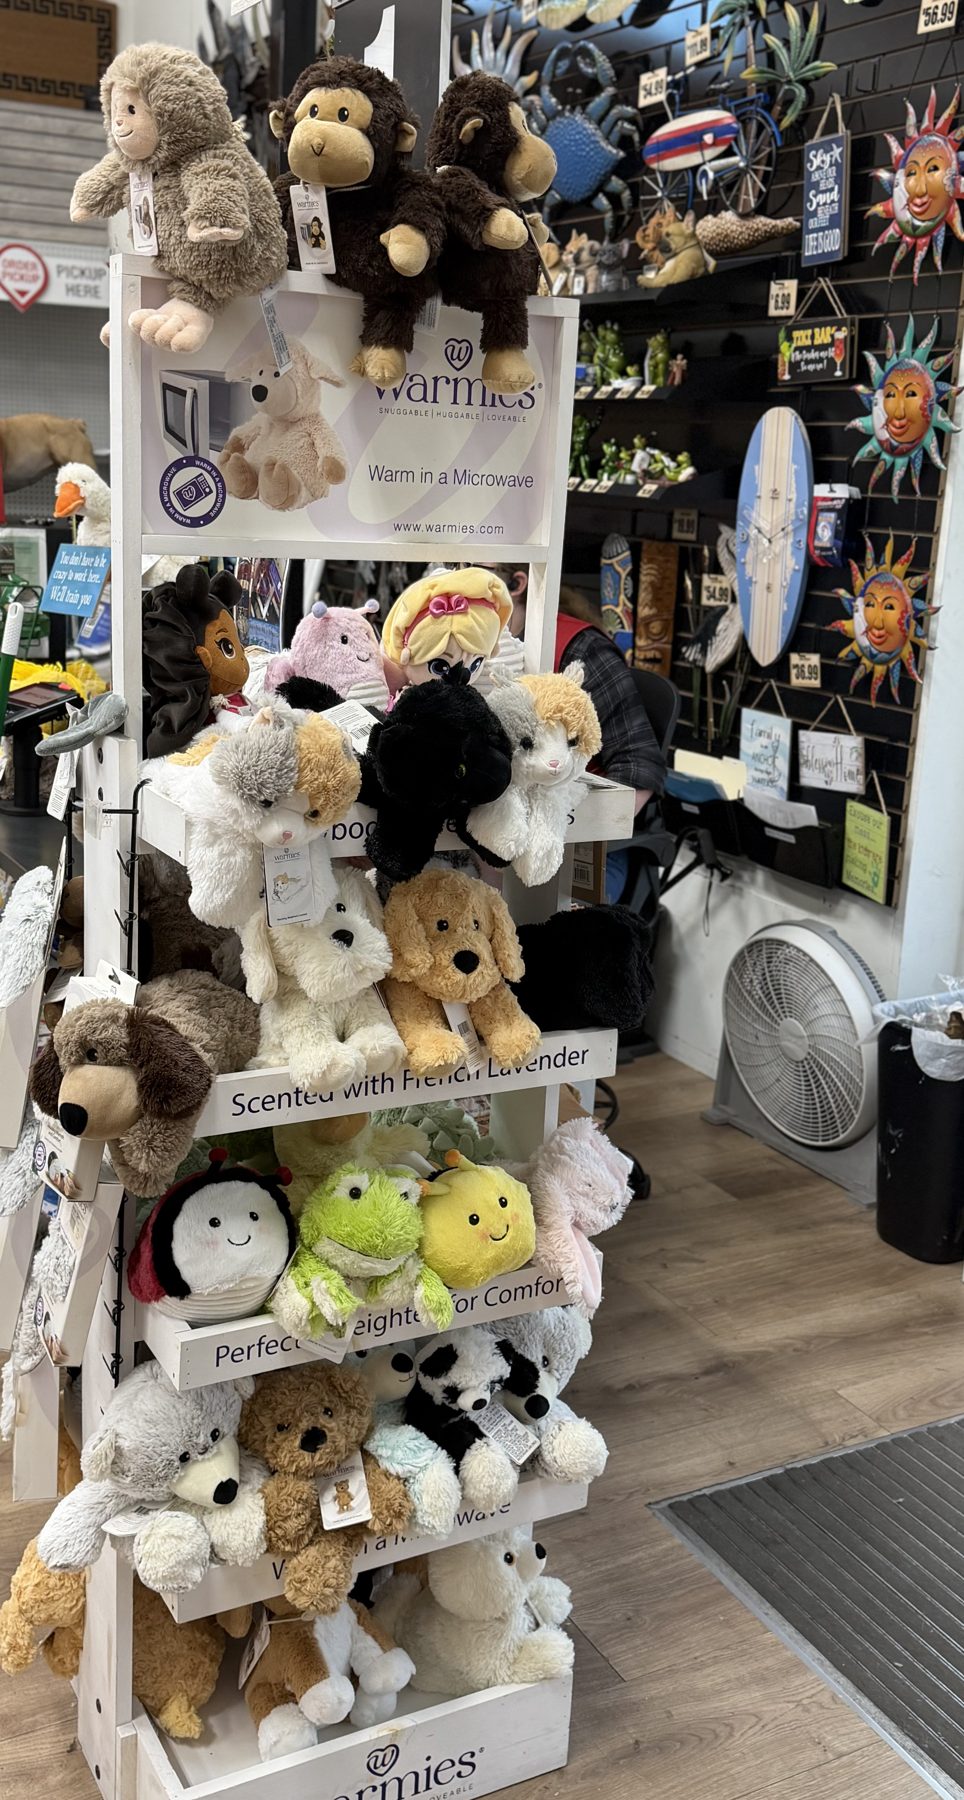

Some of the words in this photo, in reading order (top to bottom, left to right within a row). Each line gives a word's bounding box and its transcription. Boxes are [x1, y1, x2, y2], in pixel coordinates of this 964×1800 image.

[806, 148, 832, 172] Sky
[806, 184, 840, 212] Sand
[804, 233, 817, 256] LIFE
[818, 231, 824, 254] IS
[824, 228, 841, 253] GOOD
[56, 264, 107, 281] PICKUP
[65, 283, 102, 300] HERE
[792, 329, 812, 347] TIKI
[813, 326, 832, 346] BAR
[378, 407, 429, 417] SNUGGABLE
[436, 411, 480, 420] HUGGABLE
[487, 414, 527, 423] LOVEABLE
[162, 466, 177, 502] MICROWAVE
[368, 464, 415, 483] Warm
[420, 467, 433, 484] in
[438, 472, 448, 485] a
[453, 468, 534, 488] Microwave
[195, 460, 213, 471] WARM
[210, 482, 223, 518] MICROWAVE
[173, 513, 191, 524] WARM
[393, 522, 504, 535] www.warmies.com
[60, 551, 69, 566] You
[69, 551, 82, 566] don't
[81, 551, 94, 568] have
[94, 555, 100, 567] to
[100, 552, 107, 568] be
[53, 570, 68, 584] crazy
[68, 569, 74, 580] to
[73, 569, 87, 582] work
[65, 589, 80, 605] train
[77, 594, 93, 610] you
[343, 1071, 394, 1100] with
[215, 1335, 300, 1368] Perfec
[353, 1308, 420, 1337] eighte
[484, 1275, 564, 1307] Comfor
